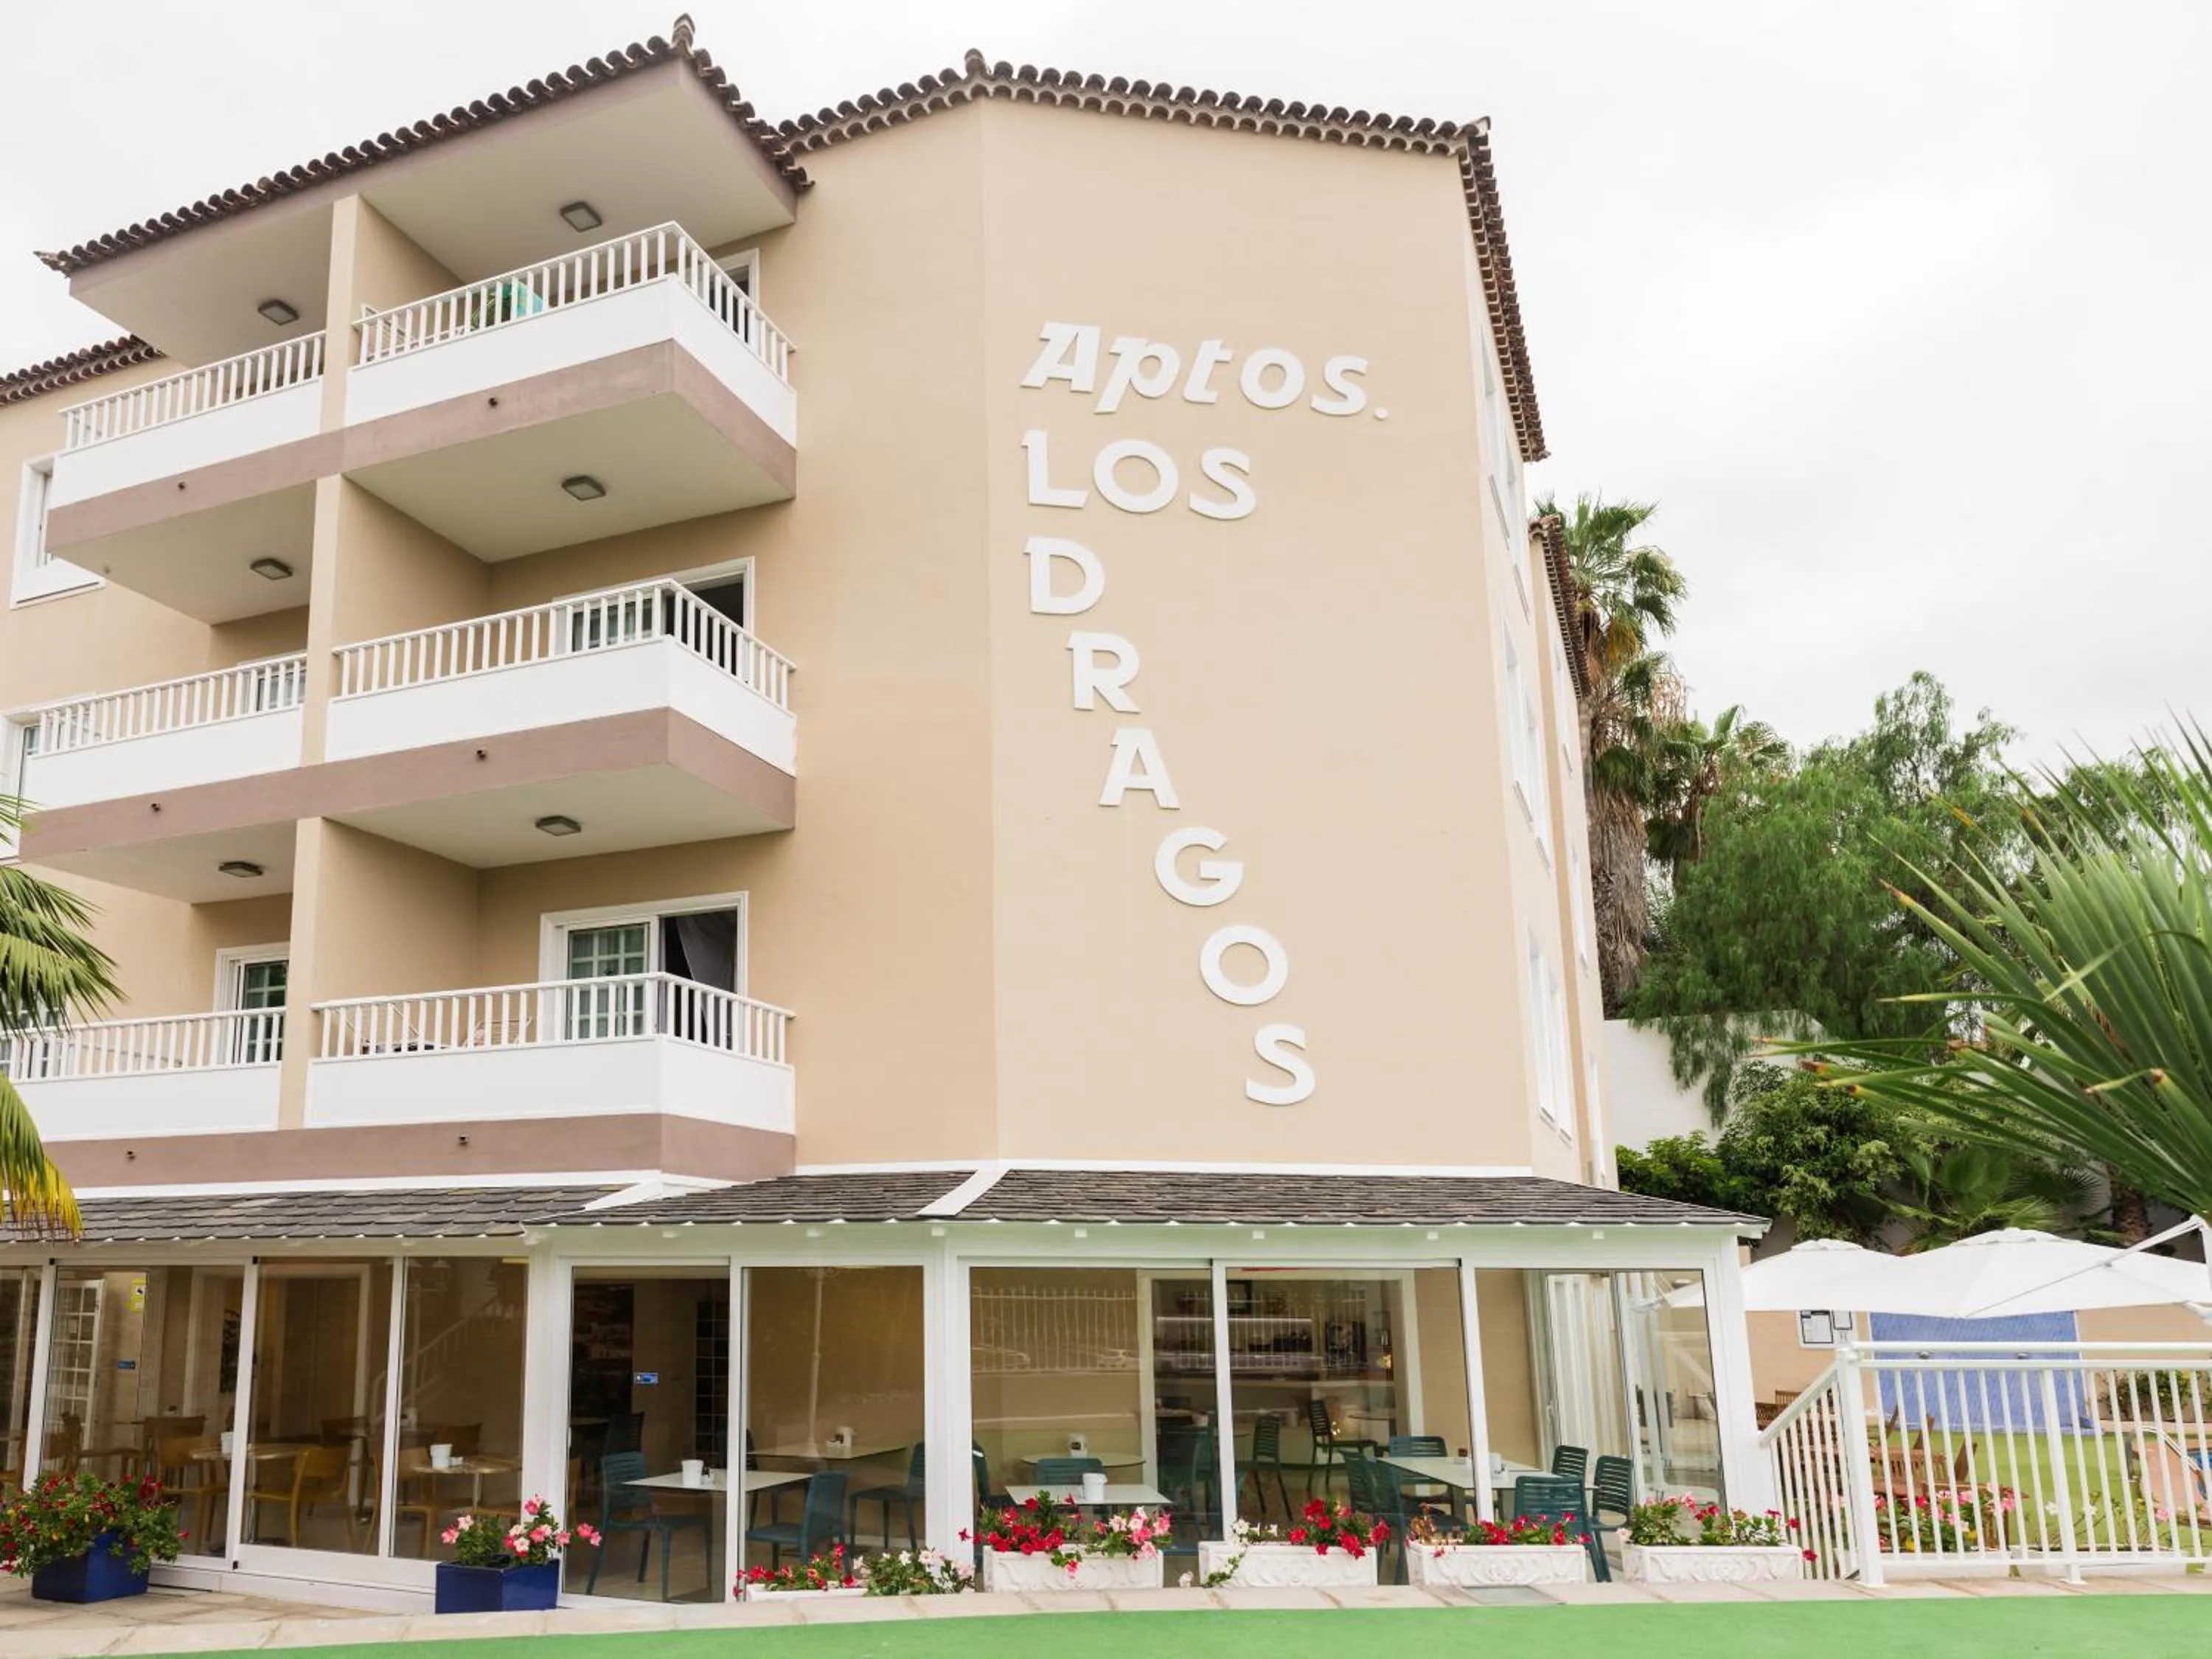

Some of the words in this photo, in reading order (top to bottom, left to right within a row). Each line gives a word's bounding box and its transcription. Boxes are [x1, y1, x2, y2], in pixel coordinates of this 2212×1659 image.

[1020, 321, 1388, 420] Aptos.
[1021, 430, 1256, 521] LOS
[1023, 536, 1316, 1107] DRAGOS
